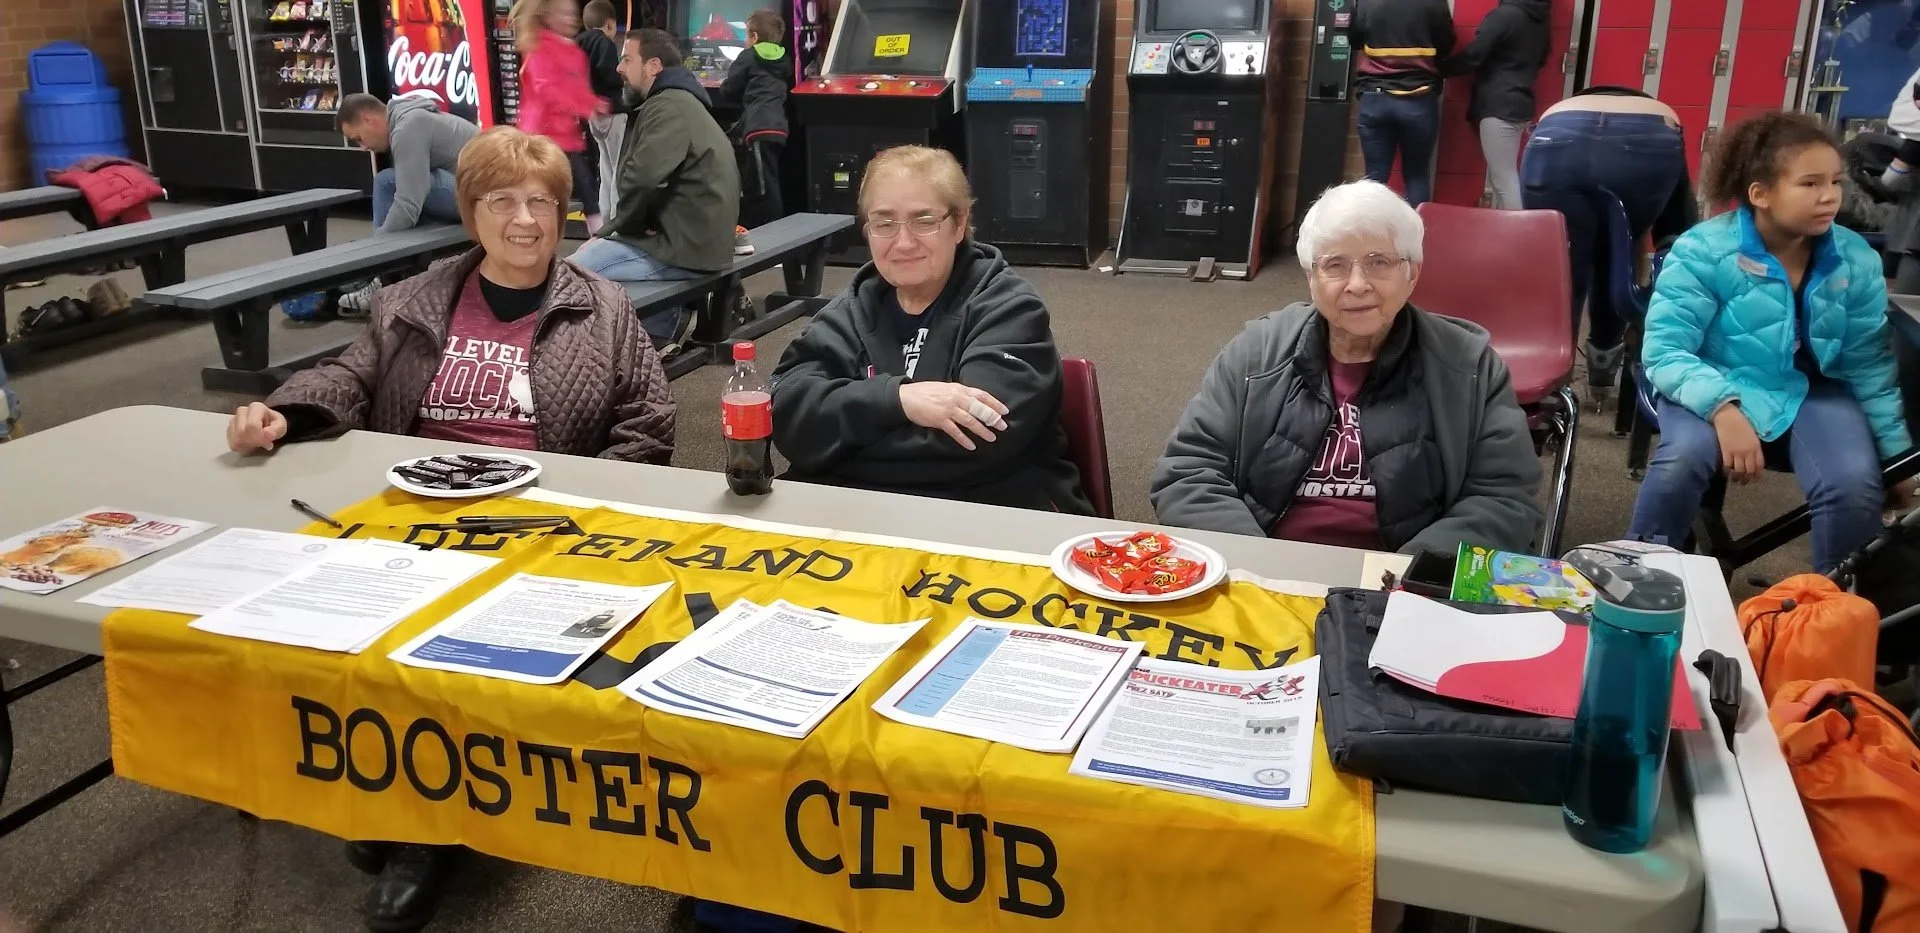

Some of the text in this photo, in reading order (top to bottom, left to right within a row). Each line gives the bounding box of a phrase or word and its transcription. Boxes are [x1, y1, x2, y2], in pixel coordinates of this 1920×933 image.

[420, 407, 513, 421] BOOSTER
[132, 520, 190, 537] NUTS
[901, 568, 1300, 671] HOCKEY
[1014, 630, 1043, 640] The
[1045, 634, 1125, 654] Puckeater
[1130, 671, 1244, 696] PUCKEATER
[291, 695, 1066, 919] BOOSTER CLUB
